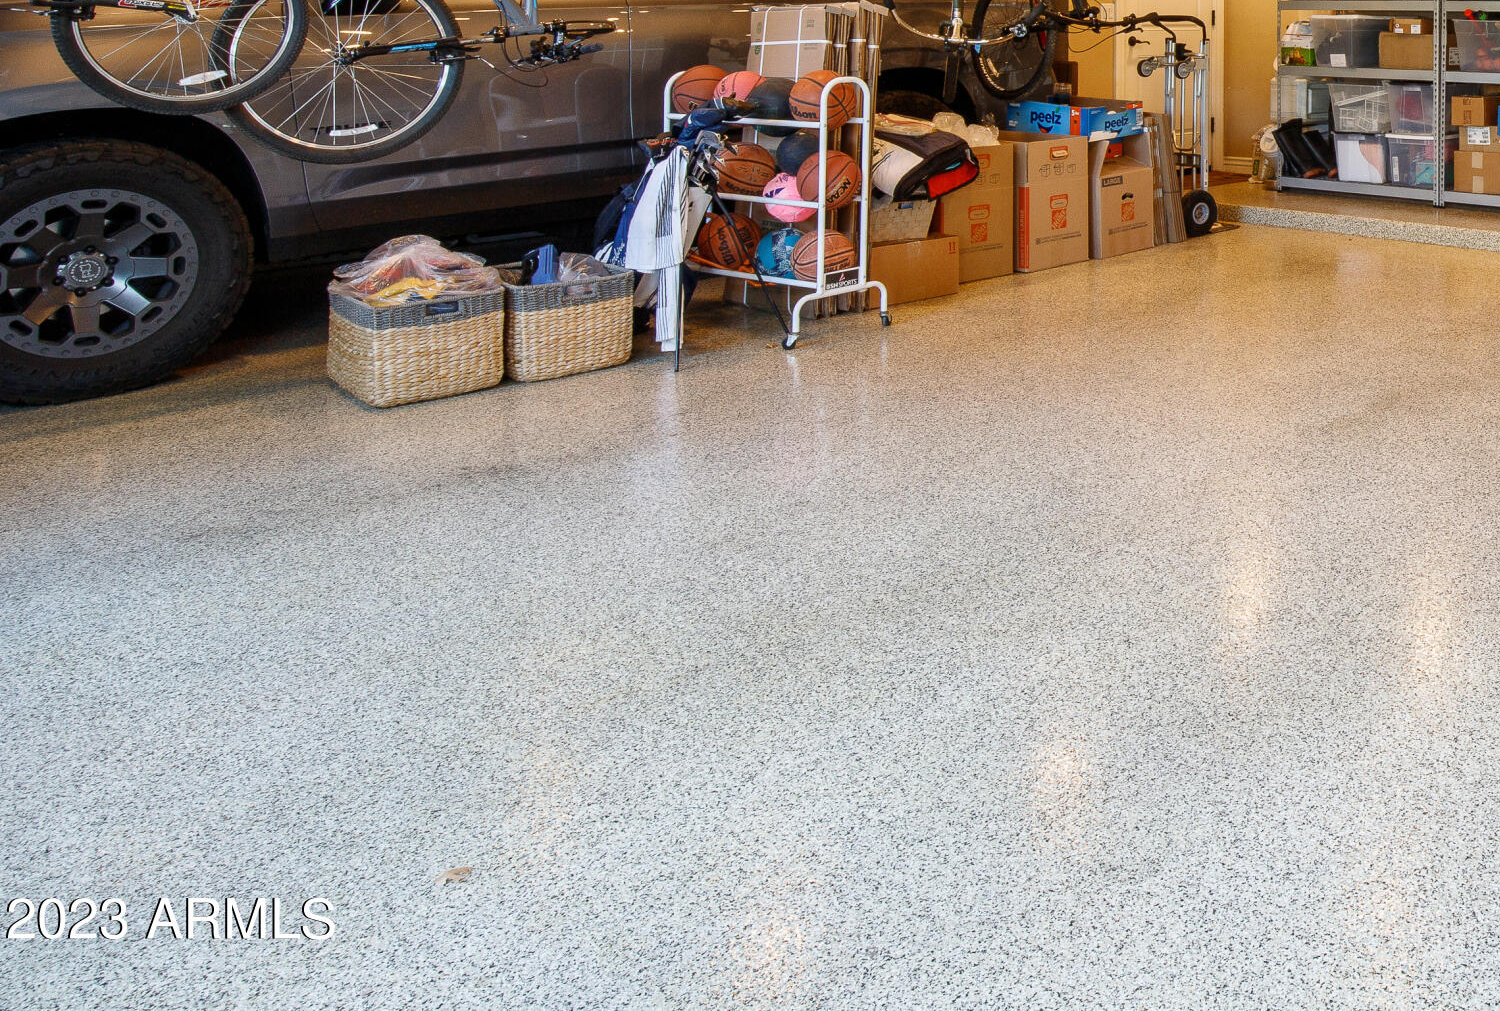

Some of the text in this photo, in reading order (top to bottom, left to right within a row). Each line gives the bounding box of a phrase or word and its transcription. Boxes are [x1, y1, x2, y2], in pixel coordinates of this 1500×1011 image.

[1029, 109, 1062, 125] peelz
[1104, 115, 1129, 130] peelz
[825, 176, 852, 204] NCAA
[839, 277, 859, 289] SPORTS
